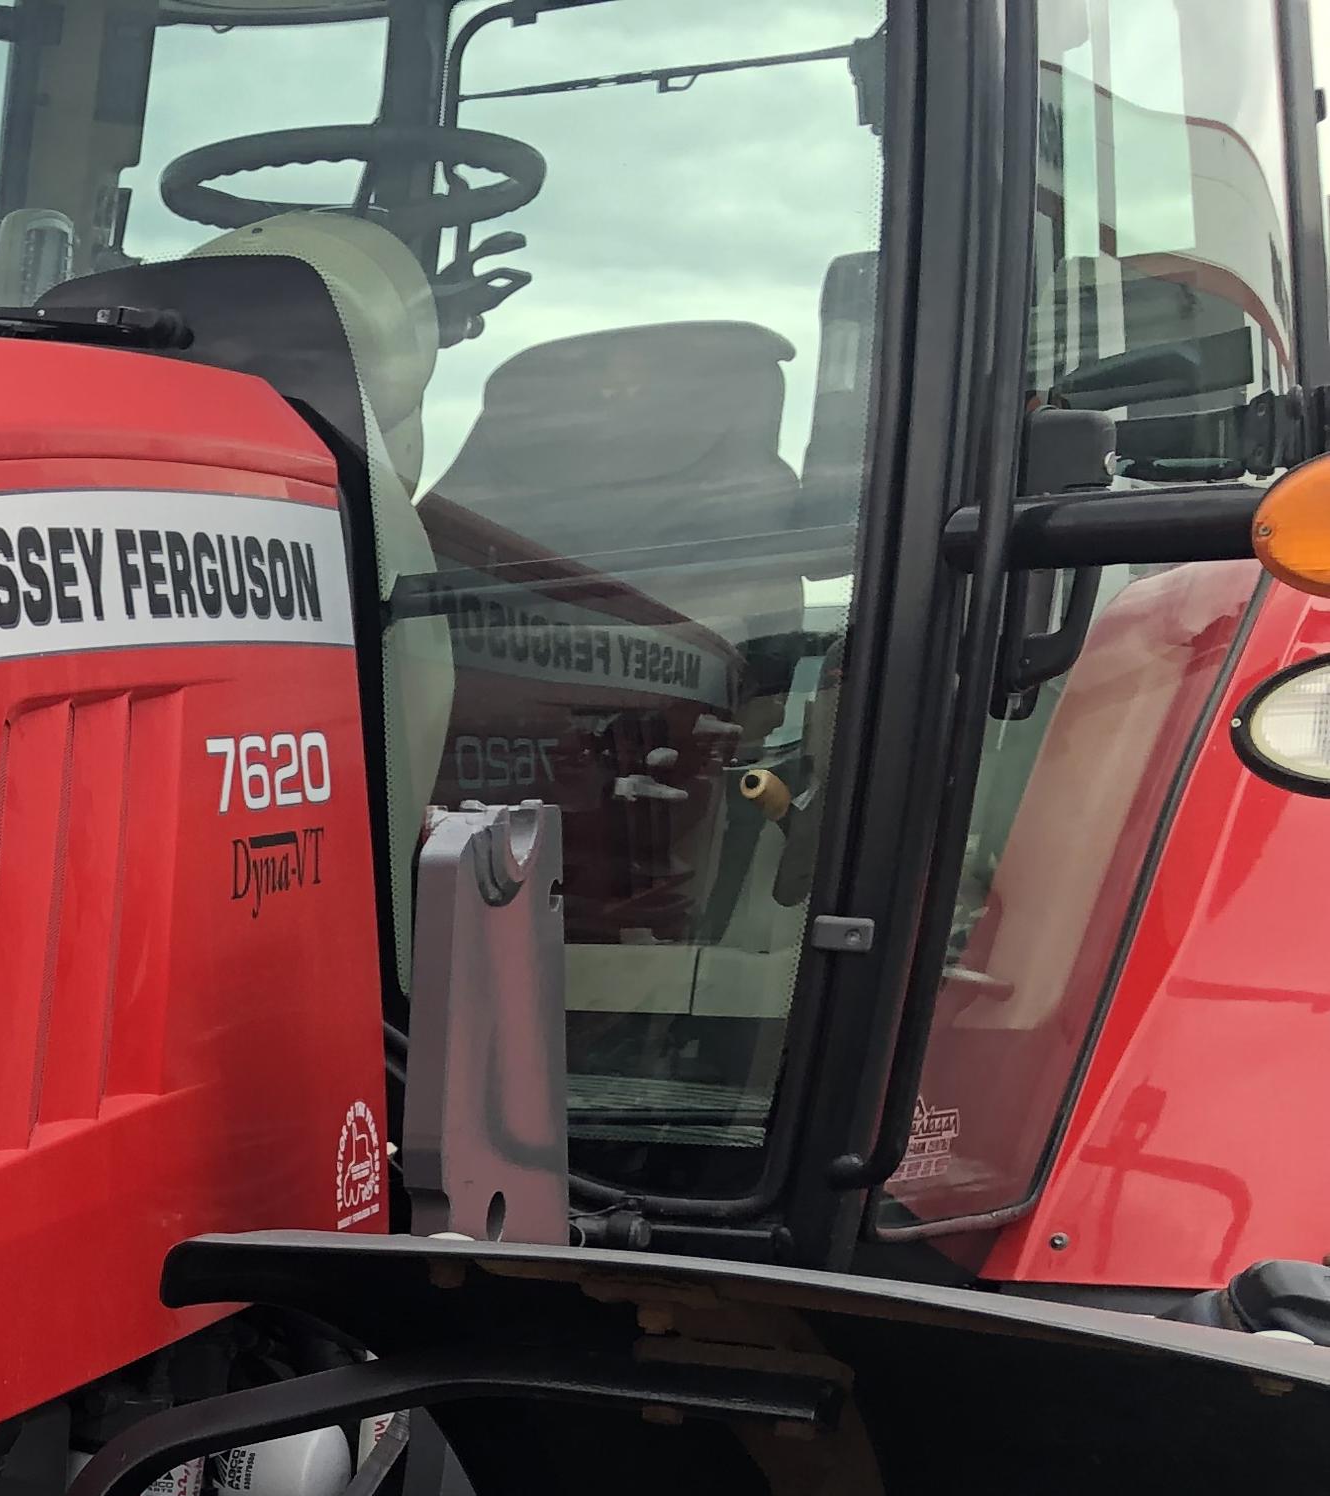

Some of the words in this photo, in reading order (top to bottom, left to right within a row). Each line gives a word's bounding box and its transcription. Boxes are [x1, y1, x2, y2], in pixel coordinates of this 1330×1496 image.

[116, 528, 323, 622] FERGUSON
[206, 731, 331, 814] 7620
[231, 827, 325, 918] Dyna-VT
[234, 1450, 246, 1490] PARTS
